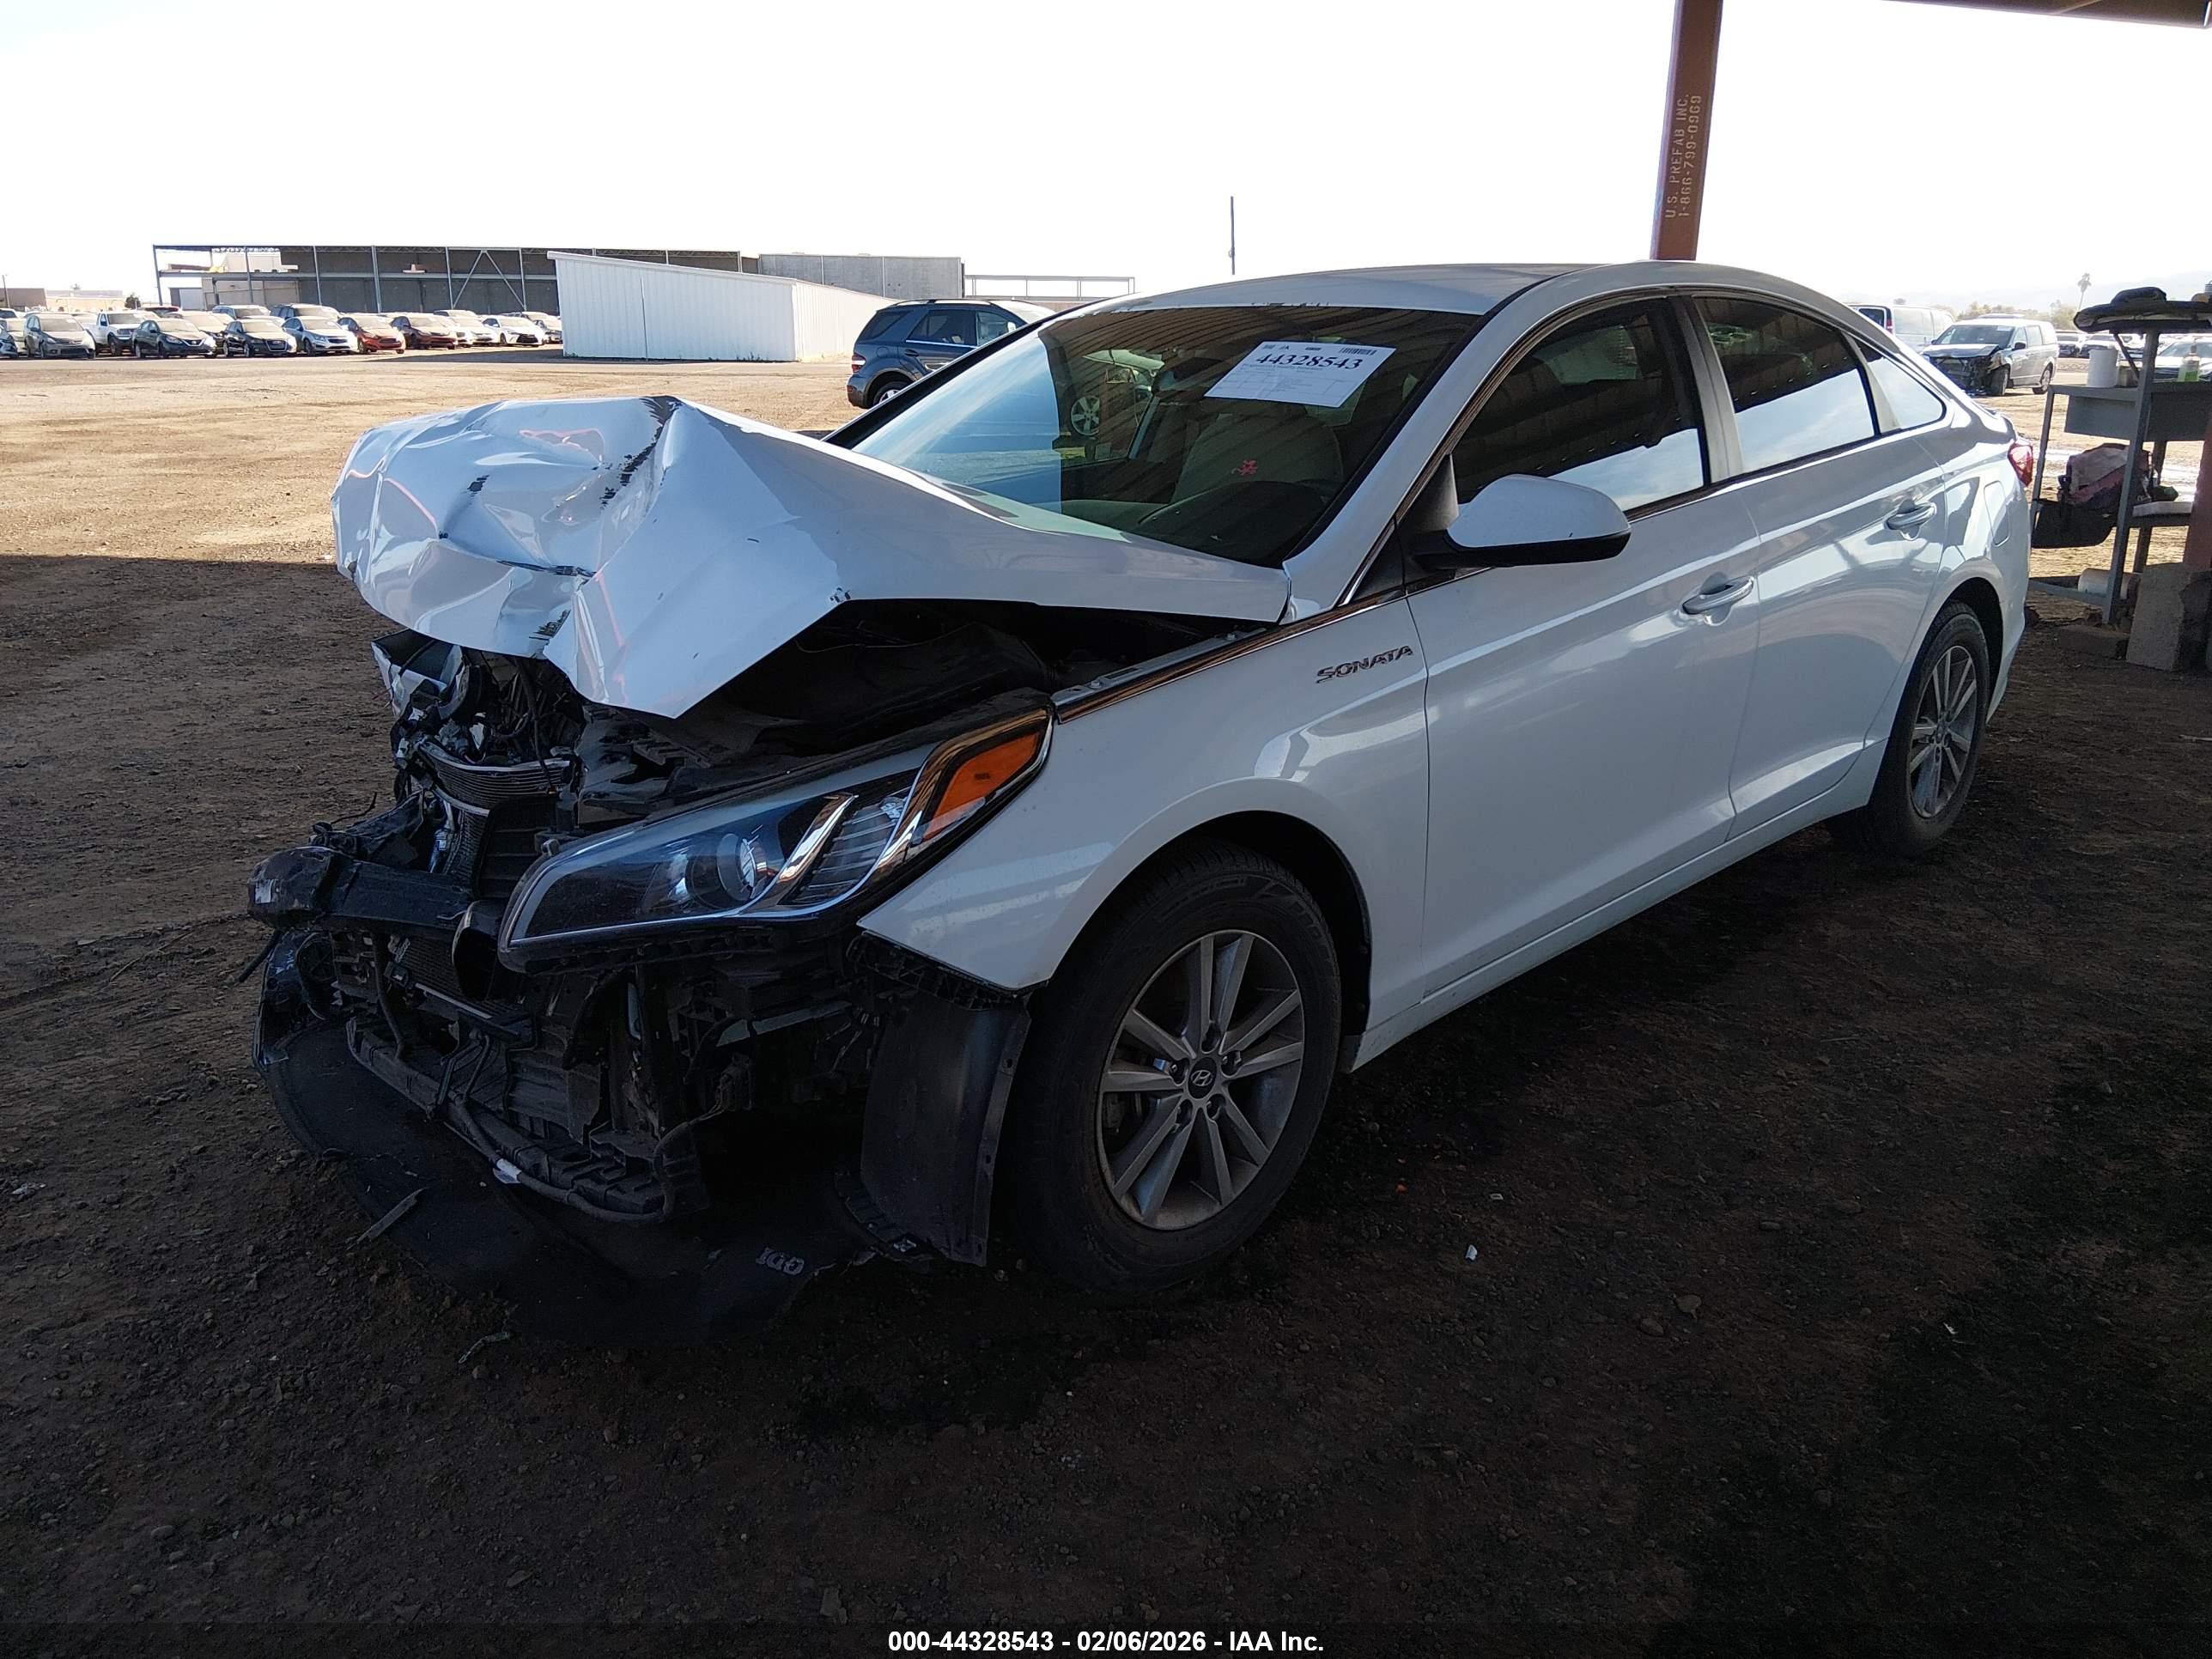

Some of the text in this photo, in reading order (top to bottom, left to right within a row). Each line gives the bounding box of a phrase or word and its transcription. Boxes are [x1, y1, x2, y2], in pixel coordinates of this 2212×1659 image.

[1665, 94, 1690, 218] U.S. PREFAB INC.
[1678, 95, 1702, 217] 1-866-799-0969
[1257, 354, 1364, 369] 44328543
[1316, 646, 1413, 684] SONATA
